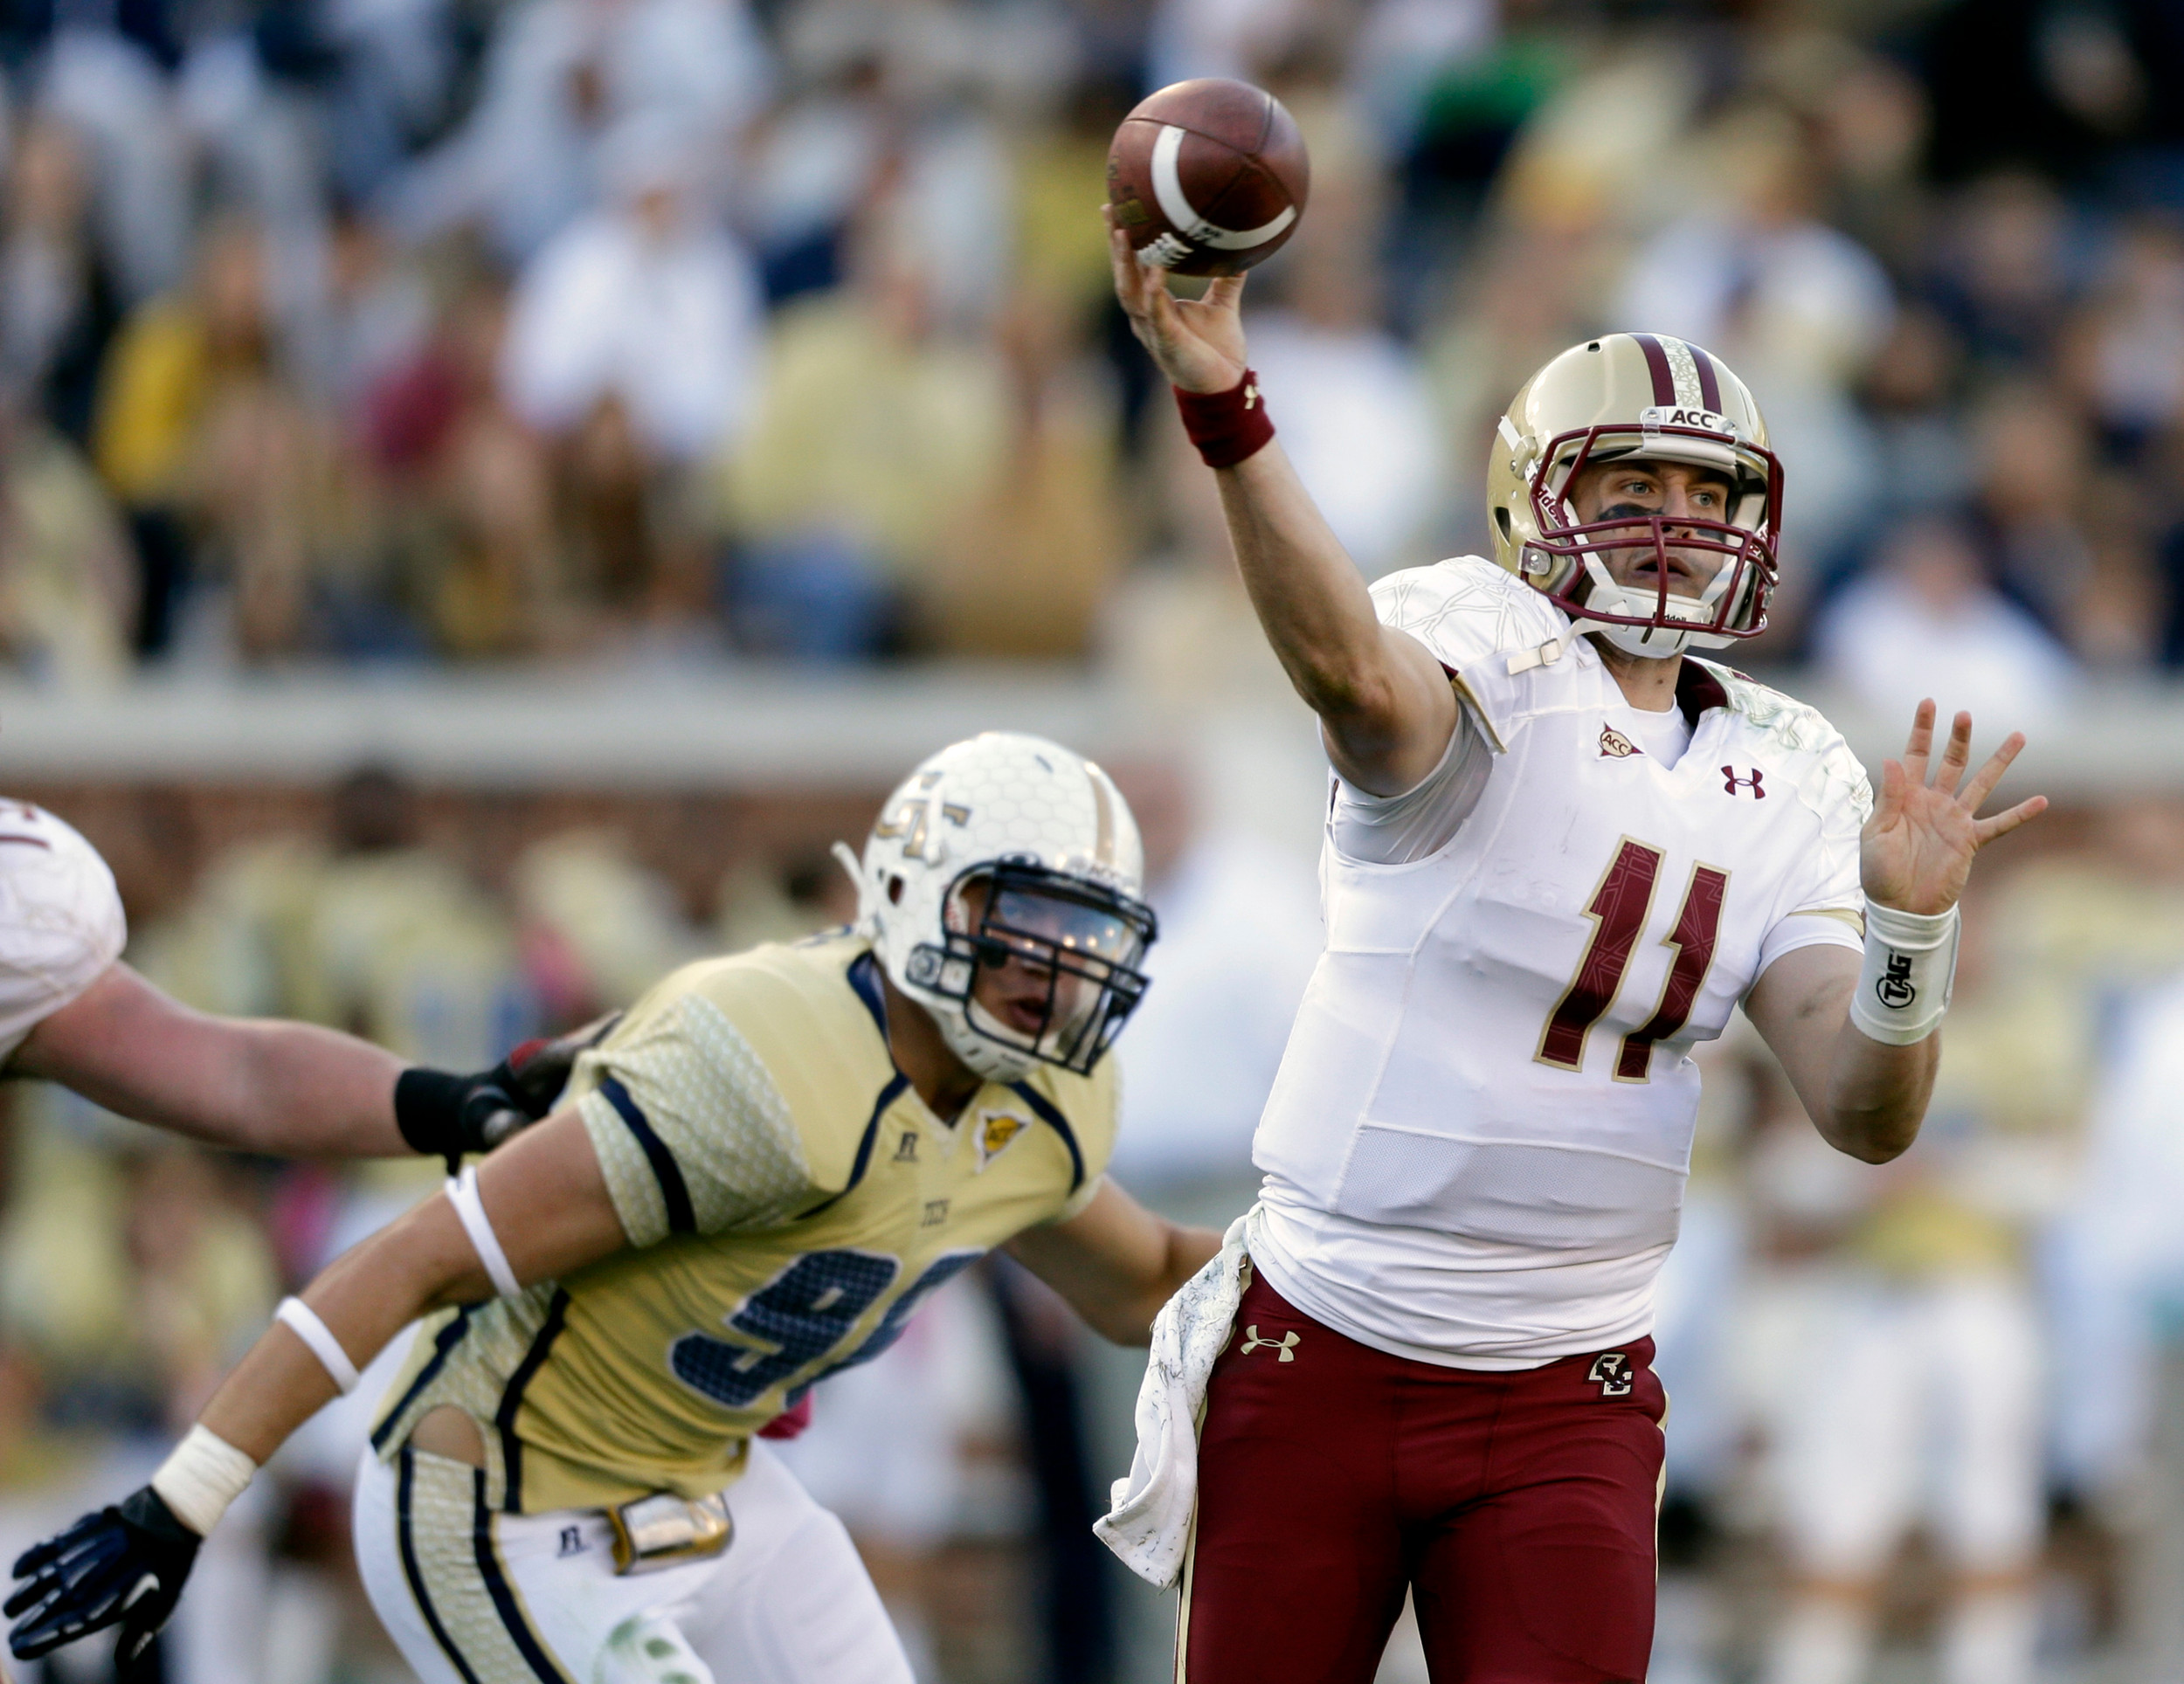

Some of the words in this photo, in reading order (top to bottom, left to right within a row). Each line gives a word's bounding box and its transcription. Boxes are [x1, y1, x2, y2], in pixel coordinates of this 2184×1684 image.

[1669, 409, 1714, 429] ACC
[1602, 734, 1628, 756] ACC
[1532, 833, 1732, 1085] 11
[1883, 948, 1912, 1001] TAG
